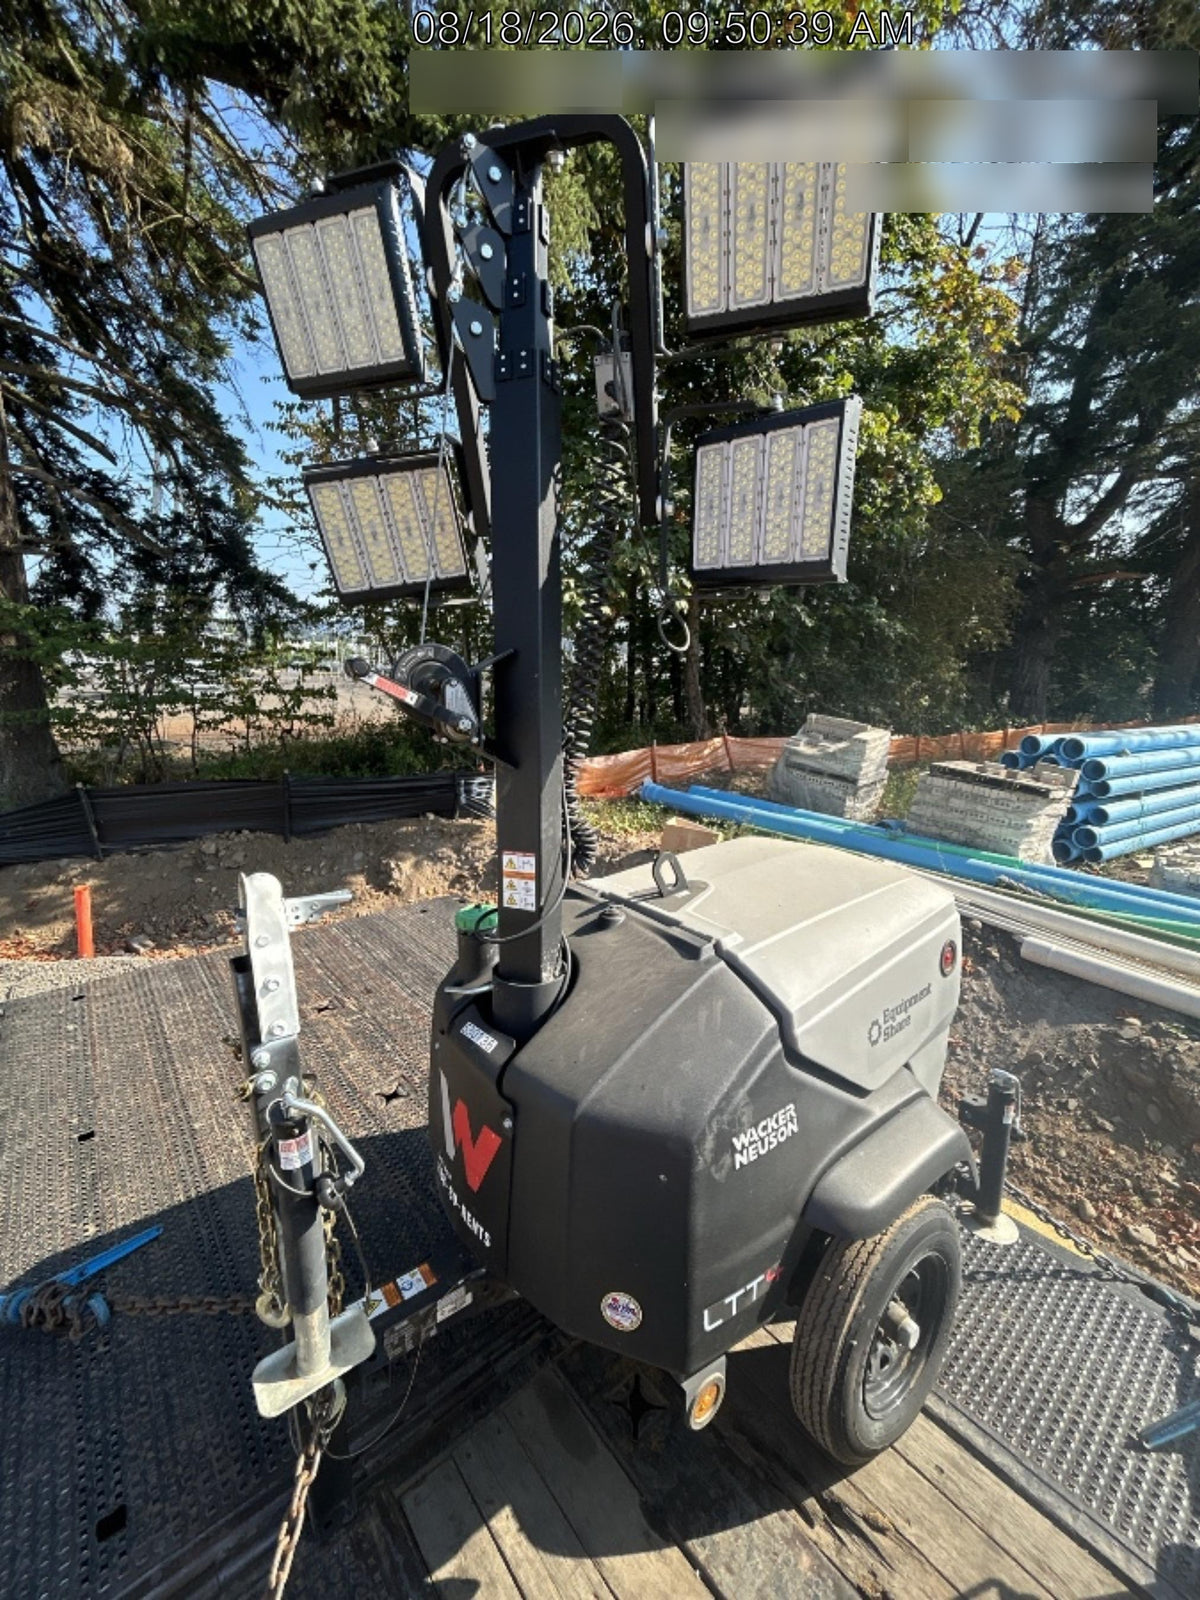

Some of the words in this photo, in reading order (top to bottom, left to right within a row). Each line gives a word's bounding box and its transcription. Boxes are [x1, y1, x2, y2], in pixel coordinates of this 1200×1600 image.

[883, 1014, 911, 1042] Share
[732, 1103, 797, 1151] WACKER
[734, 1117, 799, 1171] NEUSON
